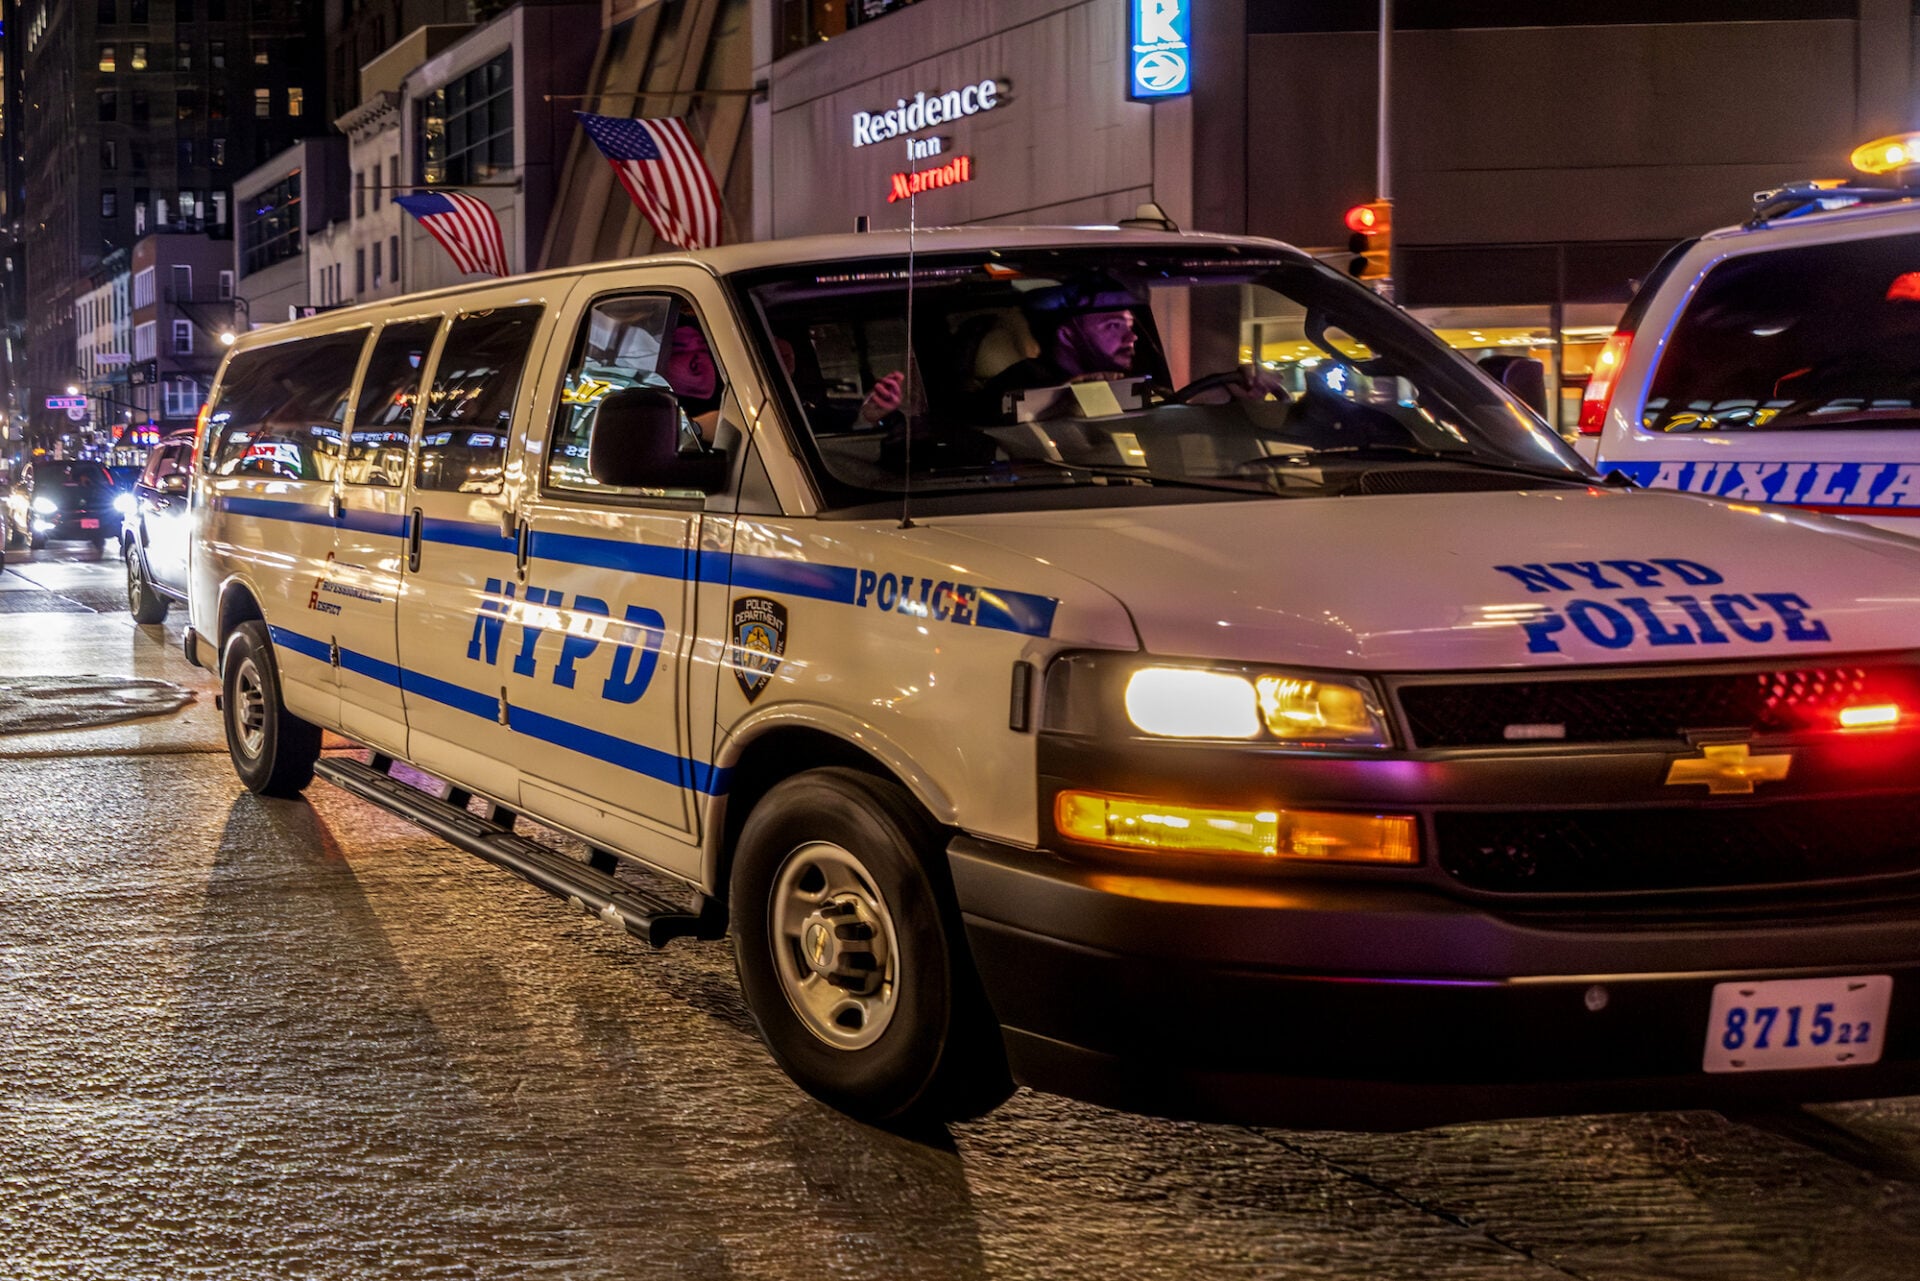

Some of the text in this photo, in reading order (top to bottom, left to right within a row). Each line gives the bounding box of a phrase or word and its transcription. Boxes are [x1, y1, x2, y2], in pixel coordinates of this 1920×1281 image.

[852, 79, 998, 148] Residence
[906, 136, 942, 161] Inn
[856, 568, 977, 626] POLICE
[1492, 558, 1725, 593] NYPD
[735, 610, 784, 632] DEPARTMENT
[745, 599, 773, 613] POLICE
[1518, 593, 1832, 654] POLICE
[467, 577, 666, 704] NYPD
[1722, 1002, 1872, 1051] 8715 22
